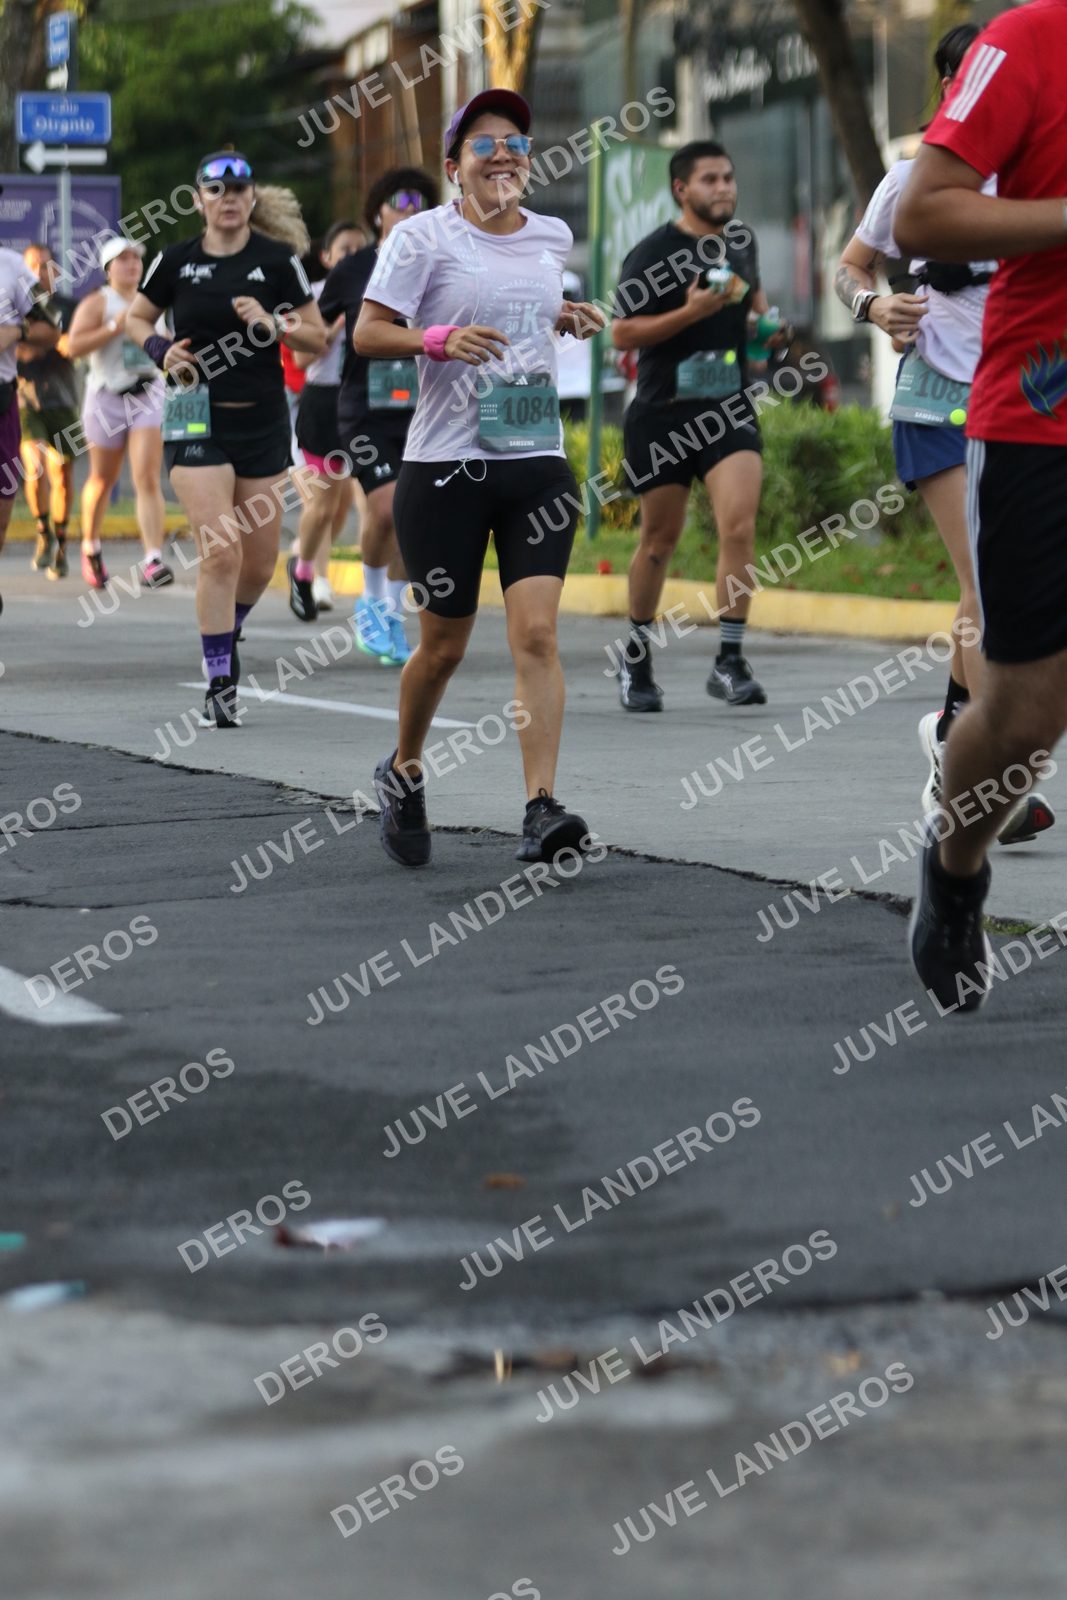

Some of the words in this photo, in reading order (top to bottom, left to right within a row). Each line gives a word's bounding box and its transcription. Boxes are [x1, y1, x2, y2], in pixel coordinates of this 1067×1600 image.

[914, 370, 969, 407] 108
[166, 400, 206, 423] 2487
[503, 395, 557, 425] 1084
